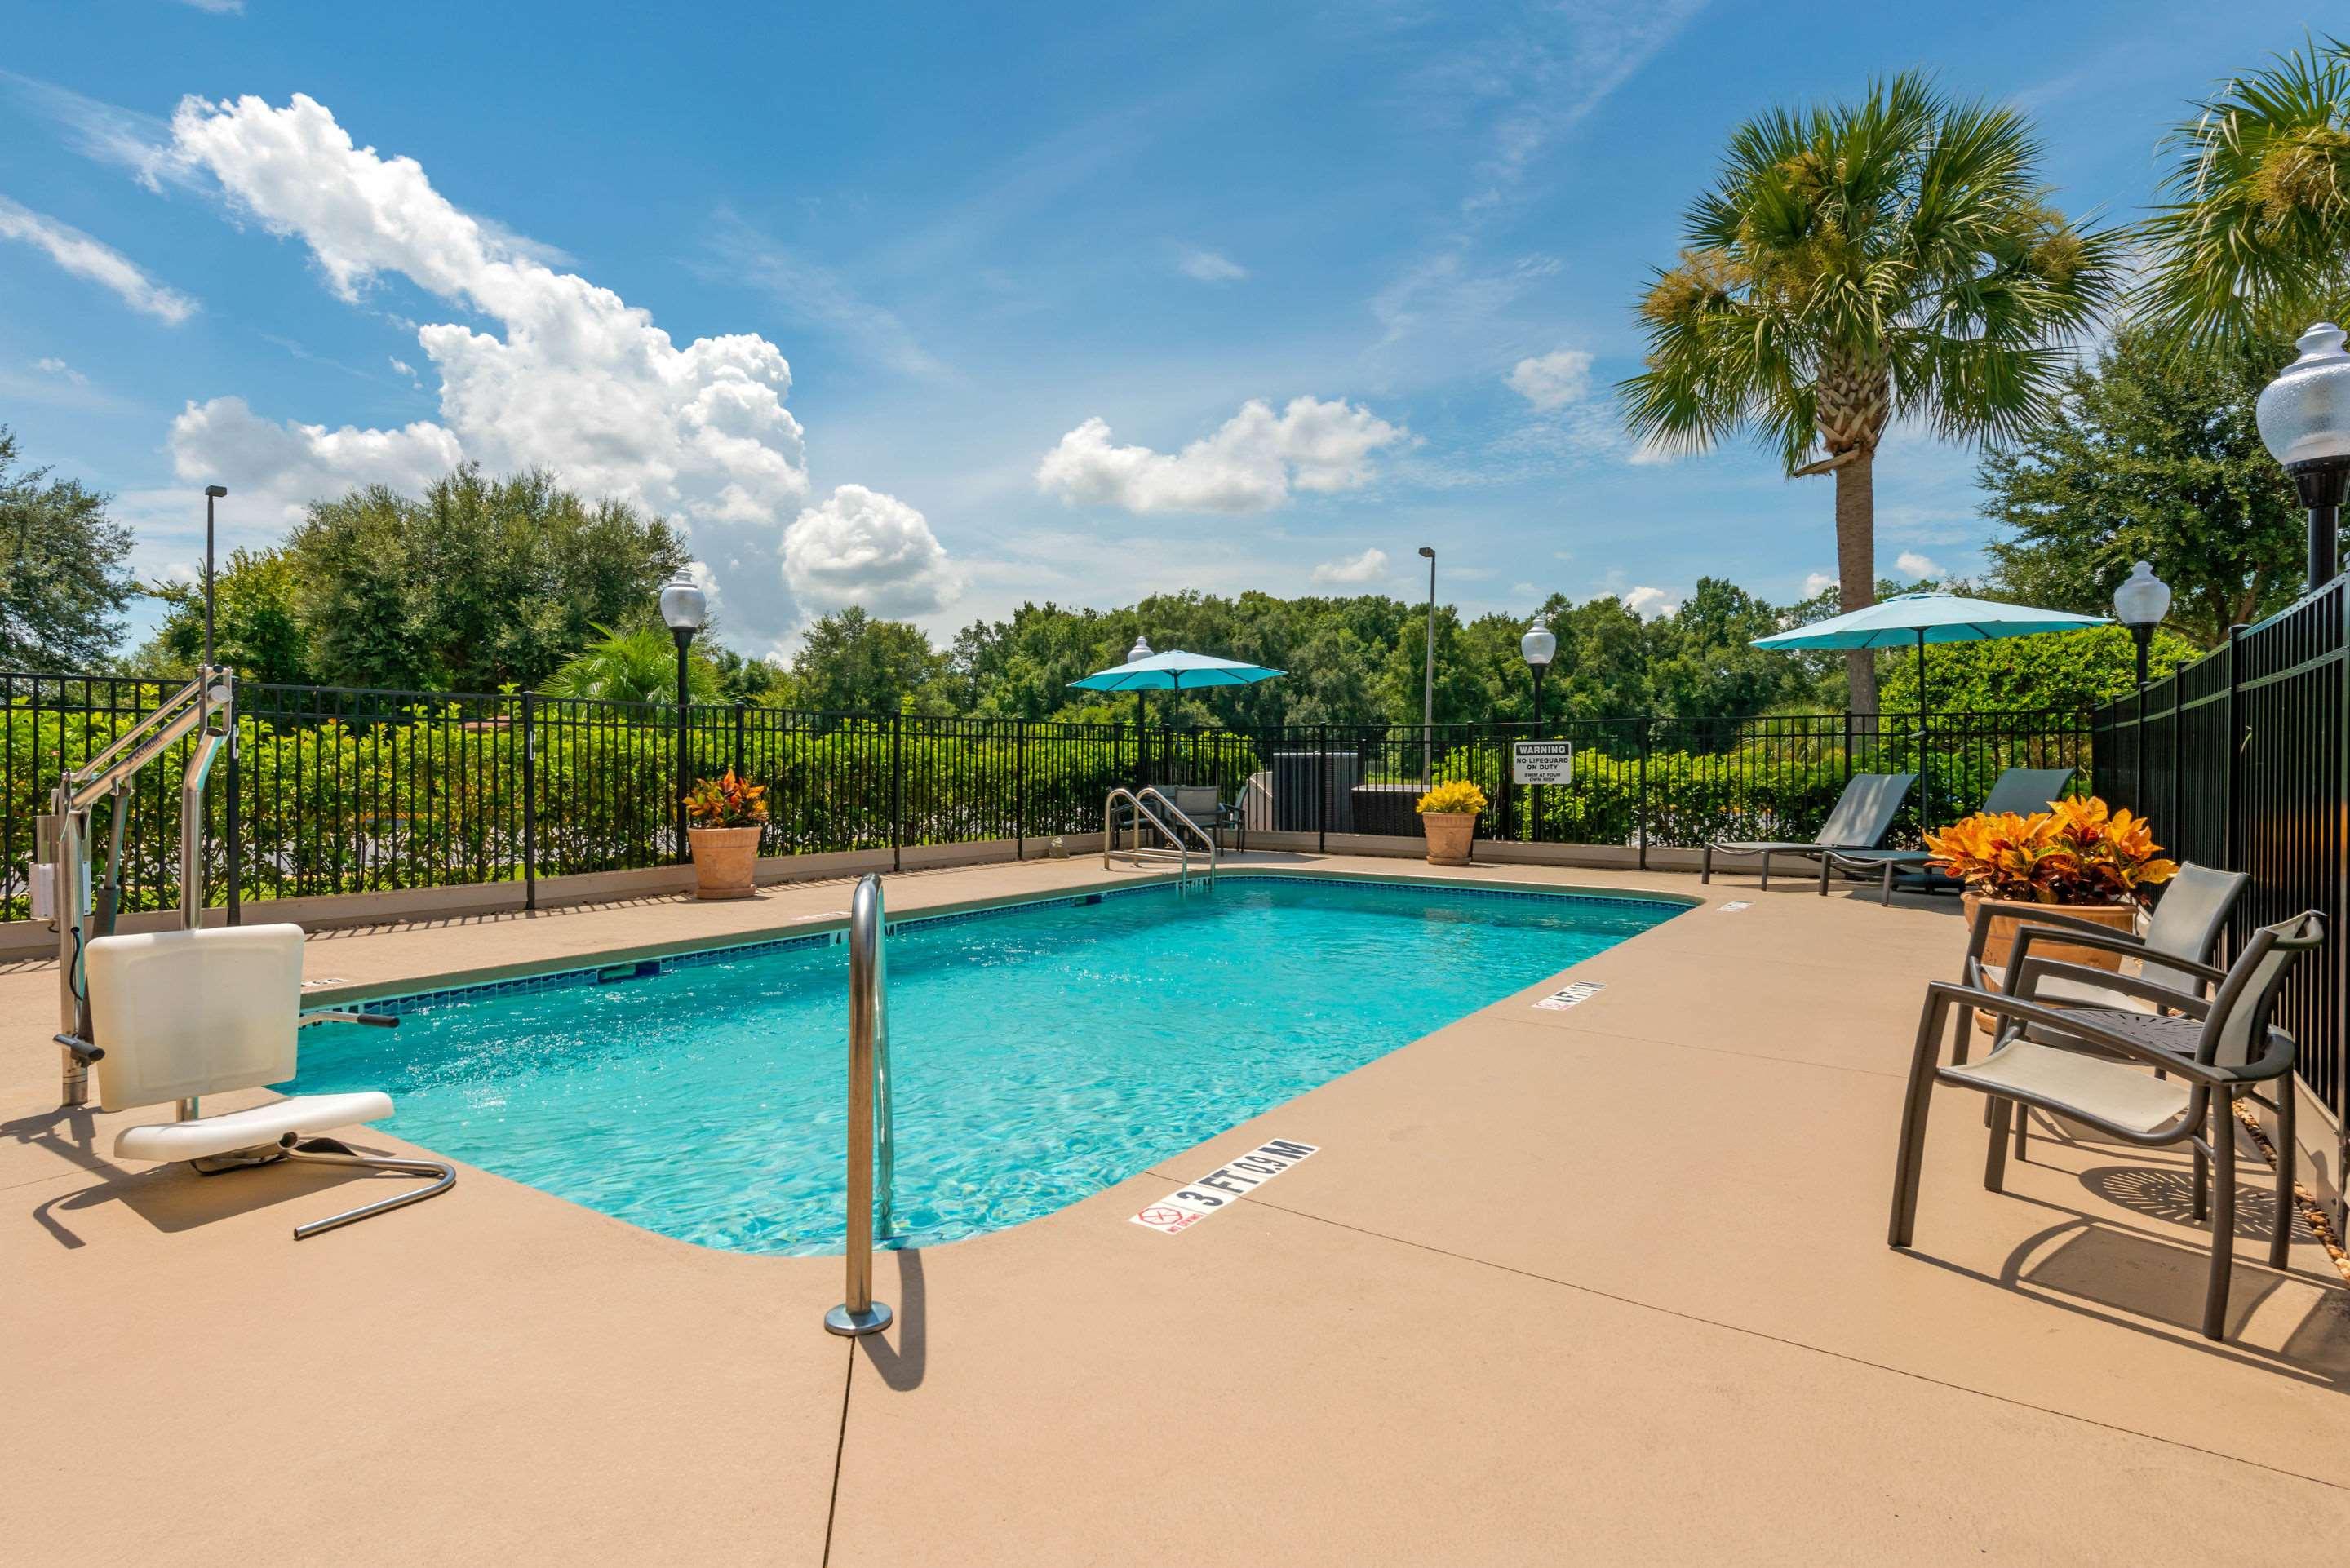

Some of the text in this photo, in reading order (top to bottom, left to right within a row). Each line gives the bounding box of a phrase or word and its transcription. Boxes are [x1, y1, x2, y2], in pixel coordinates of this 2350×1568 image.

[1519, 746, 1566, 754] WARNING
[1176, 1141, 1316, 1207] 3 FT 0.9 M
